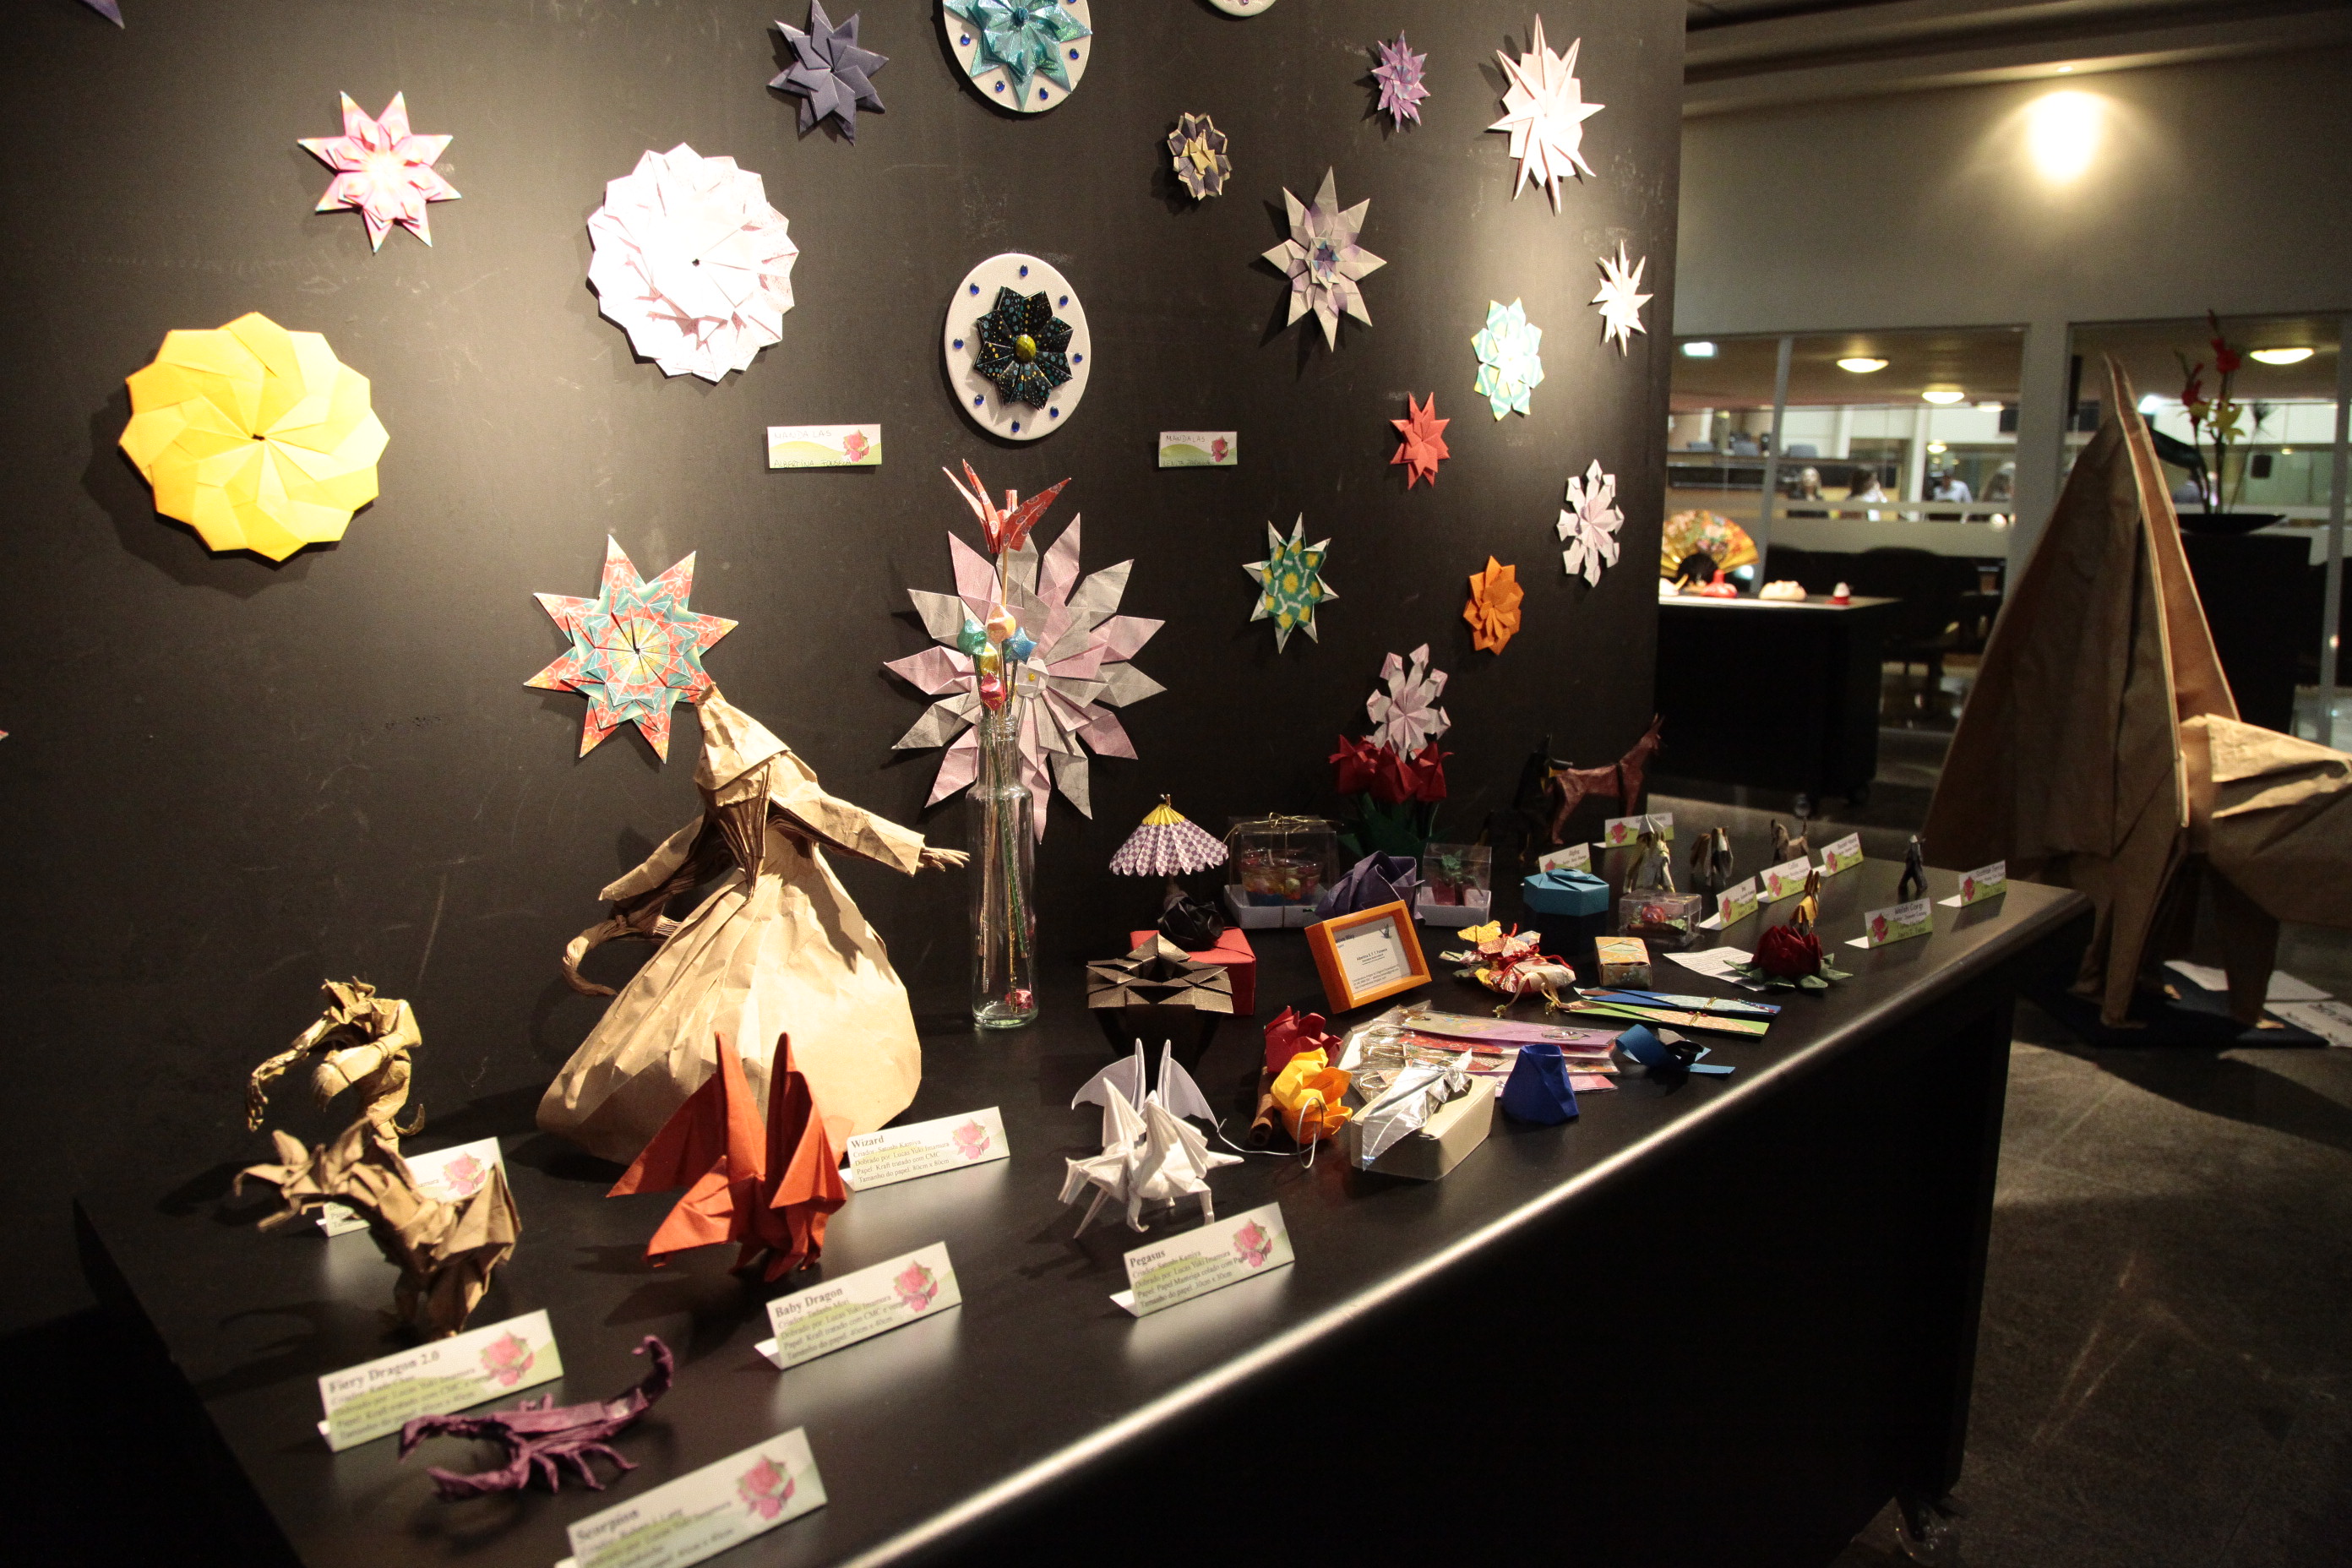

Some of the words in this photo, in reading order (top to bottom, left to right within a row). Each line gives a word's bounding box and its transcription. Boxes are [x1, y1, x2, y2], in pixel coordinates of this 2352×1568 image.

[852, 1135, 884, 1149] Wizard
[855, 1157, 879, 1167] Dobrado
[925, 1142, 950, 1151] Imamura
[859, 1173, 885, 1183] Tamanho
[1130, 1250, 1166, 1266] Pegasus
[776, 1304, 803, 1317] Baby
[805, 1289, 844, 1306] Dragon
[329, 1377, 365, 1393] Fiery
[368, 1361, 417, 1380] Dragon
[420, 1350, 441, 1364] 2.0
